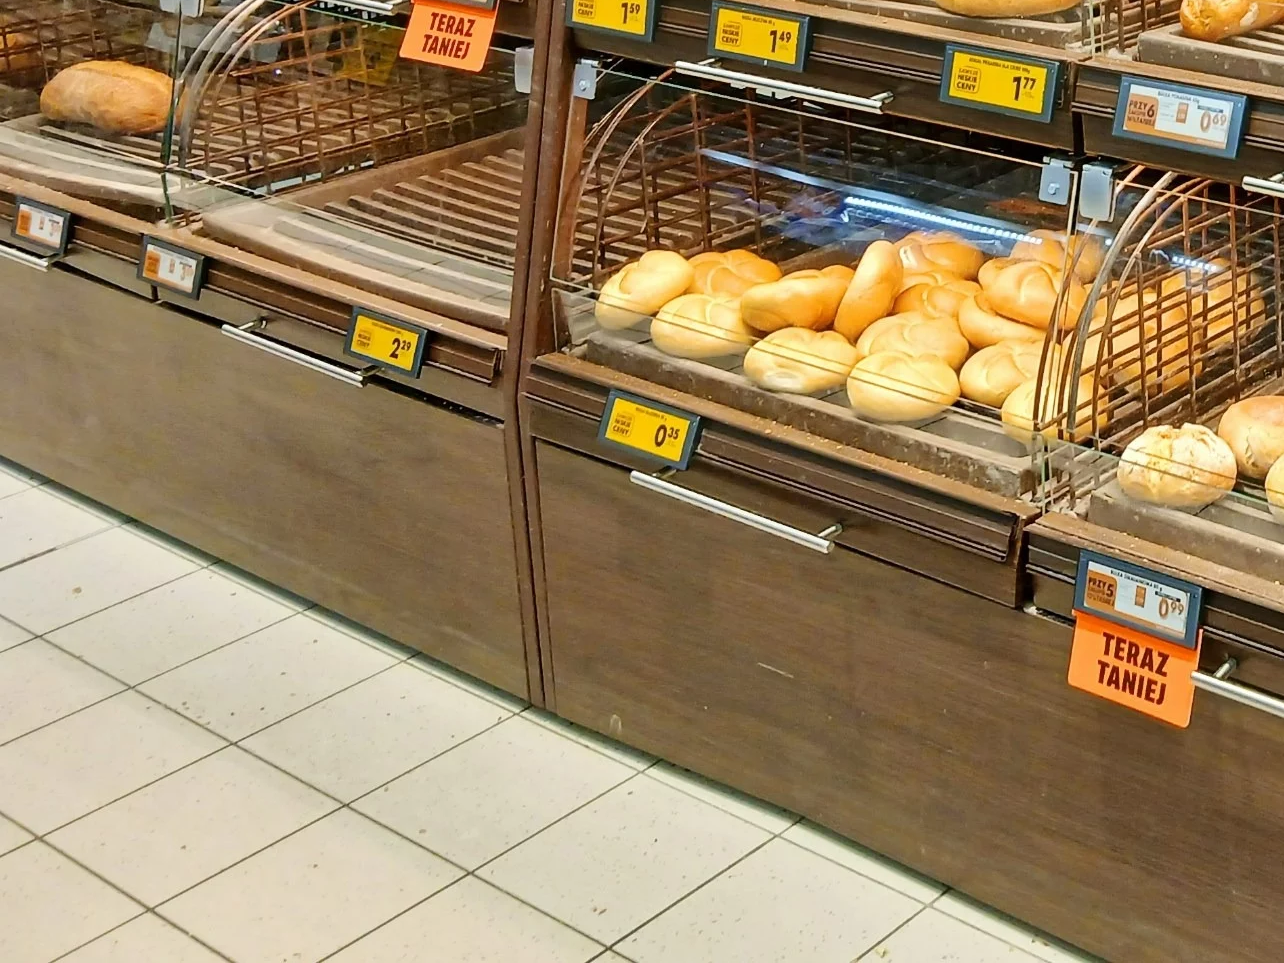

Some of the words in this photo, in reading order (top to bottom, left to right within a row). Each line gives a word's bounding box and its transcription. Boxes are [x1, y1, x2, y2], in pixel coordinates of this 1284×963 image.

[577, 8, 593, 18] CENY
[429, 11, 477, 38] TERAZ
[421, 33, 471, 60] TANIEJ
[721, 35, 739, 46] CENY
[957, 74, 978, 84] NISKIE
[956, 81, 977, 92] CENY
[1129, 99, 1148, 110] PRZY
[1147, 104, 1156, 119] 6
[612, 425, 629, 436] CENY
[1105, 584, 1114, 598] 5
[1102, 631, 1170, 678] TERAZ
[1097, 659, 1167, 705] TANIEJ
